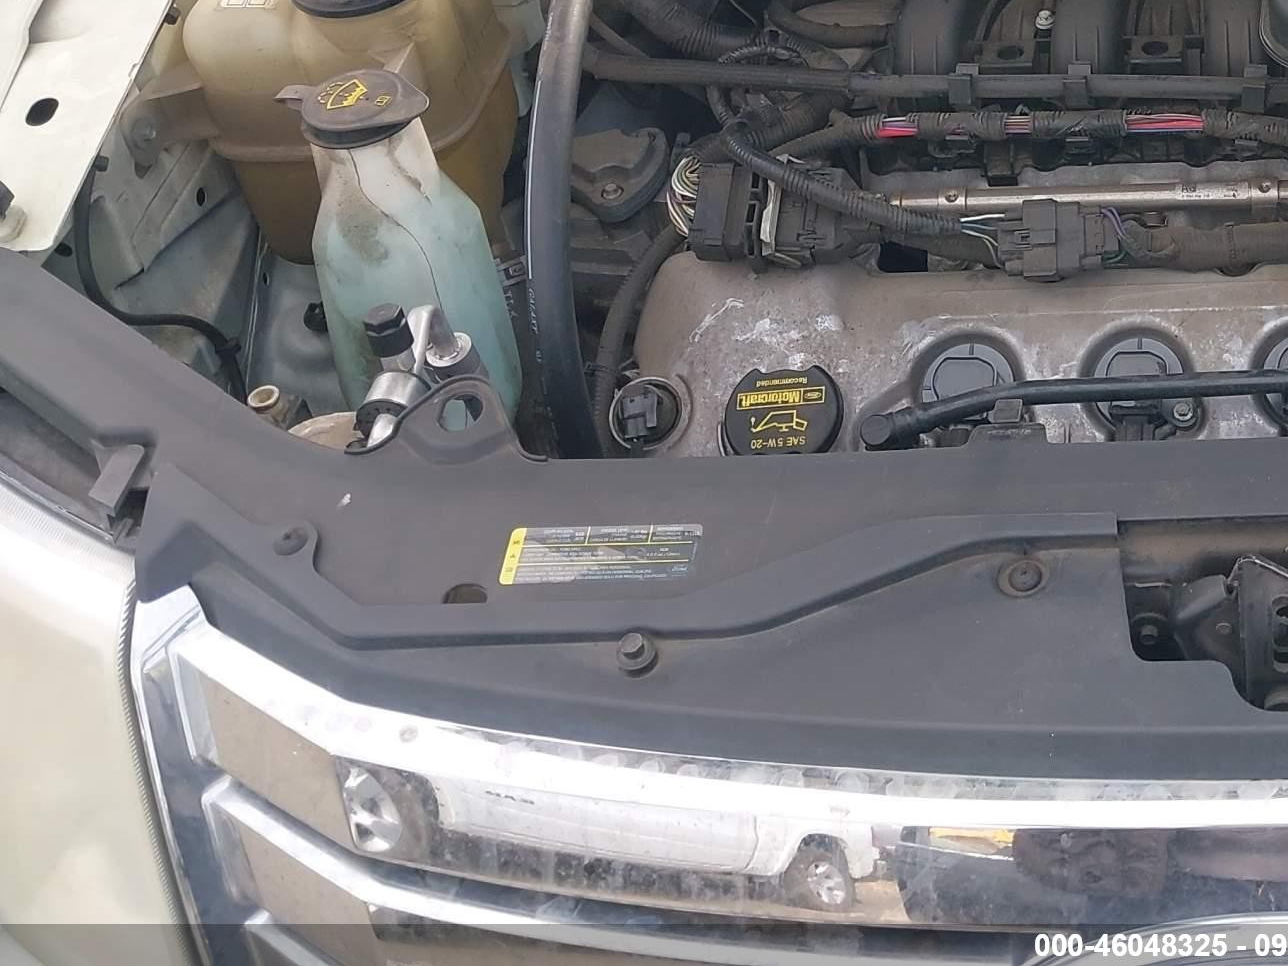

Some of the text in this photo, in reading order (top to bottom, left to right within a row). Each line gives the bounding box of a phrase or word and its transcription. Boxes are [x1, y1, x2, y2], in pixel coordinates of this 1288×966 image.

[756, 376, 808, 387] Recommended
[741, 390, 801, 407] Motorcraft
[750, 436, 806, 449] SAE 5W-20
